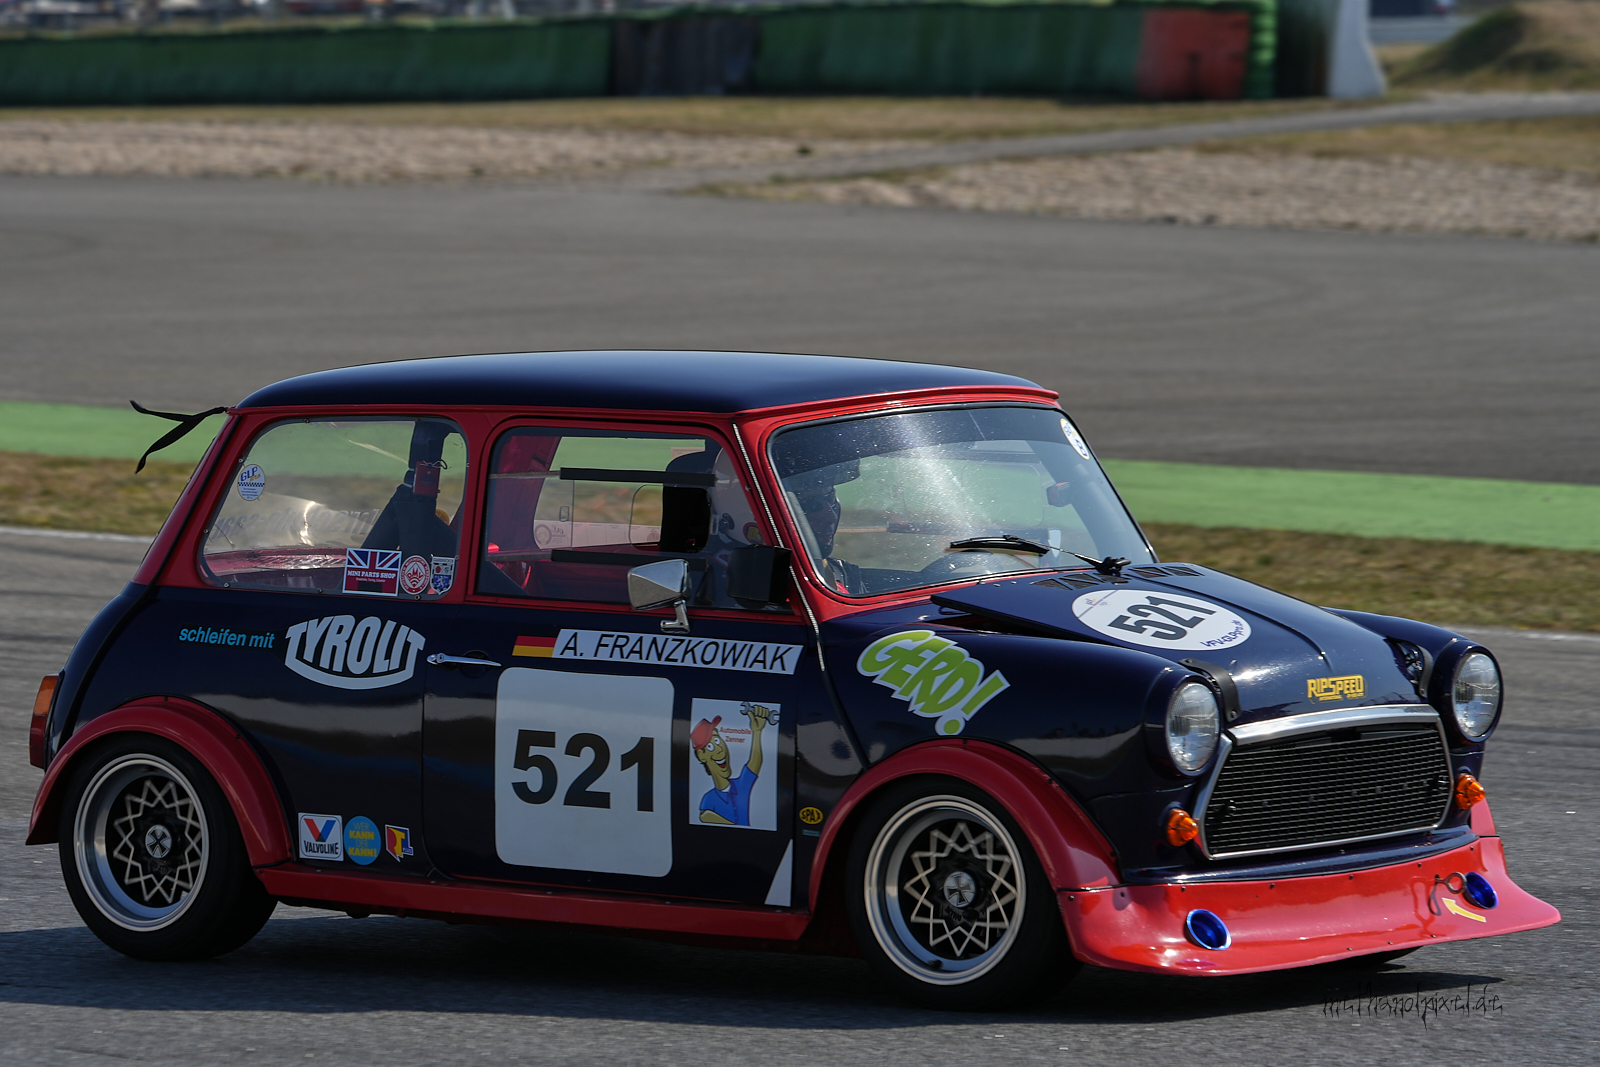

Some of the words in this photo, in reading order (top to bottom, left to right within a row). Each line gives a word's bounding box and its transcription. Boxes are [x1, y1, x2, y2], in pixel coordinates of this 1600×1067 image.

[240, 466, 258, 482] GLP
[380, 572, 397, 580] SHOP
[1107, 595, 1217, 641] 521
[178, 626, 247, 647] schleifen
[249, 631, 276, 649] mit
[285, 614, 426, 680] TYROLIT
[560, 631, 584, 657] A.
[593, 633, 795, 671] FRANZKOWIAK
[858, 630, 1009, 735] GERD!
[1307, 675, 1364, 698] RIPSPEED
[720, 727, 752, 736] Automobile
[511, 729, 655, 813] 521
[349, 830, 375, 840] KANN
[352, 822, 370, 831] WER
[303, 840, 339, 855] VALVOLINE
[348, 847, 377, 858] KANN!
